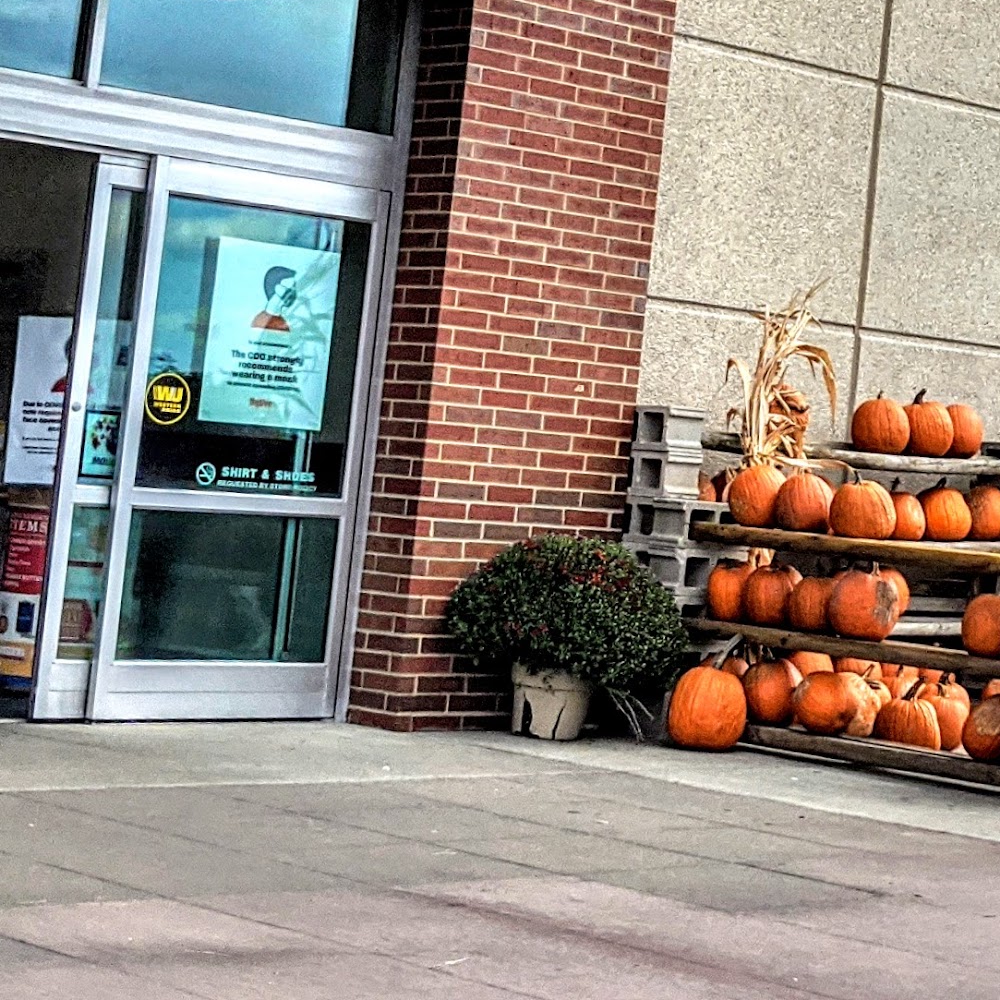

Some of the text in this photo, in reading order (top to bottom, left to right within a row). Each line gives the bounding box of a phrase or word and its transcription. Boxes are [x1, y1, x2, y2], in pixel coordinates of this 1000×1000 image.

[231, 371, 266, 382] wearing
[221, 466, 316, 482] SHIRT & SHOES
